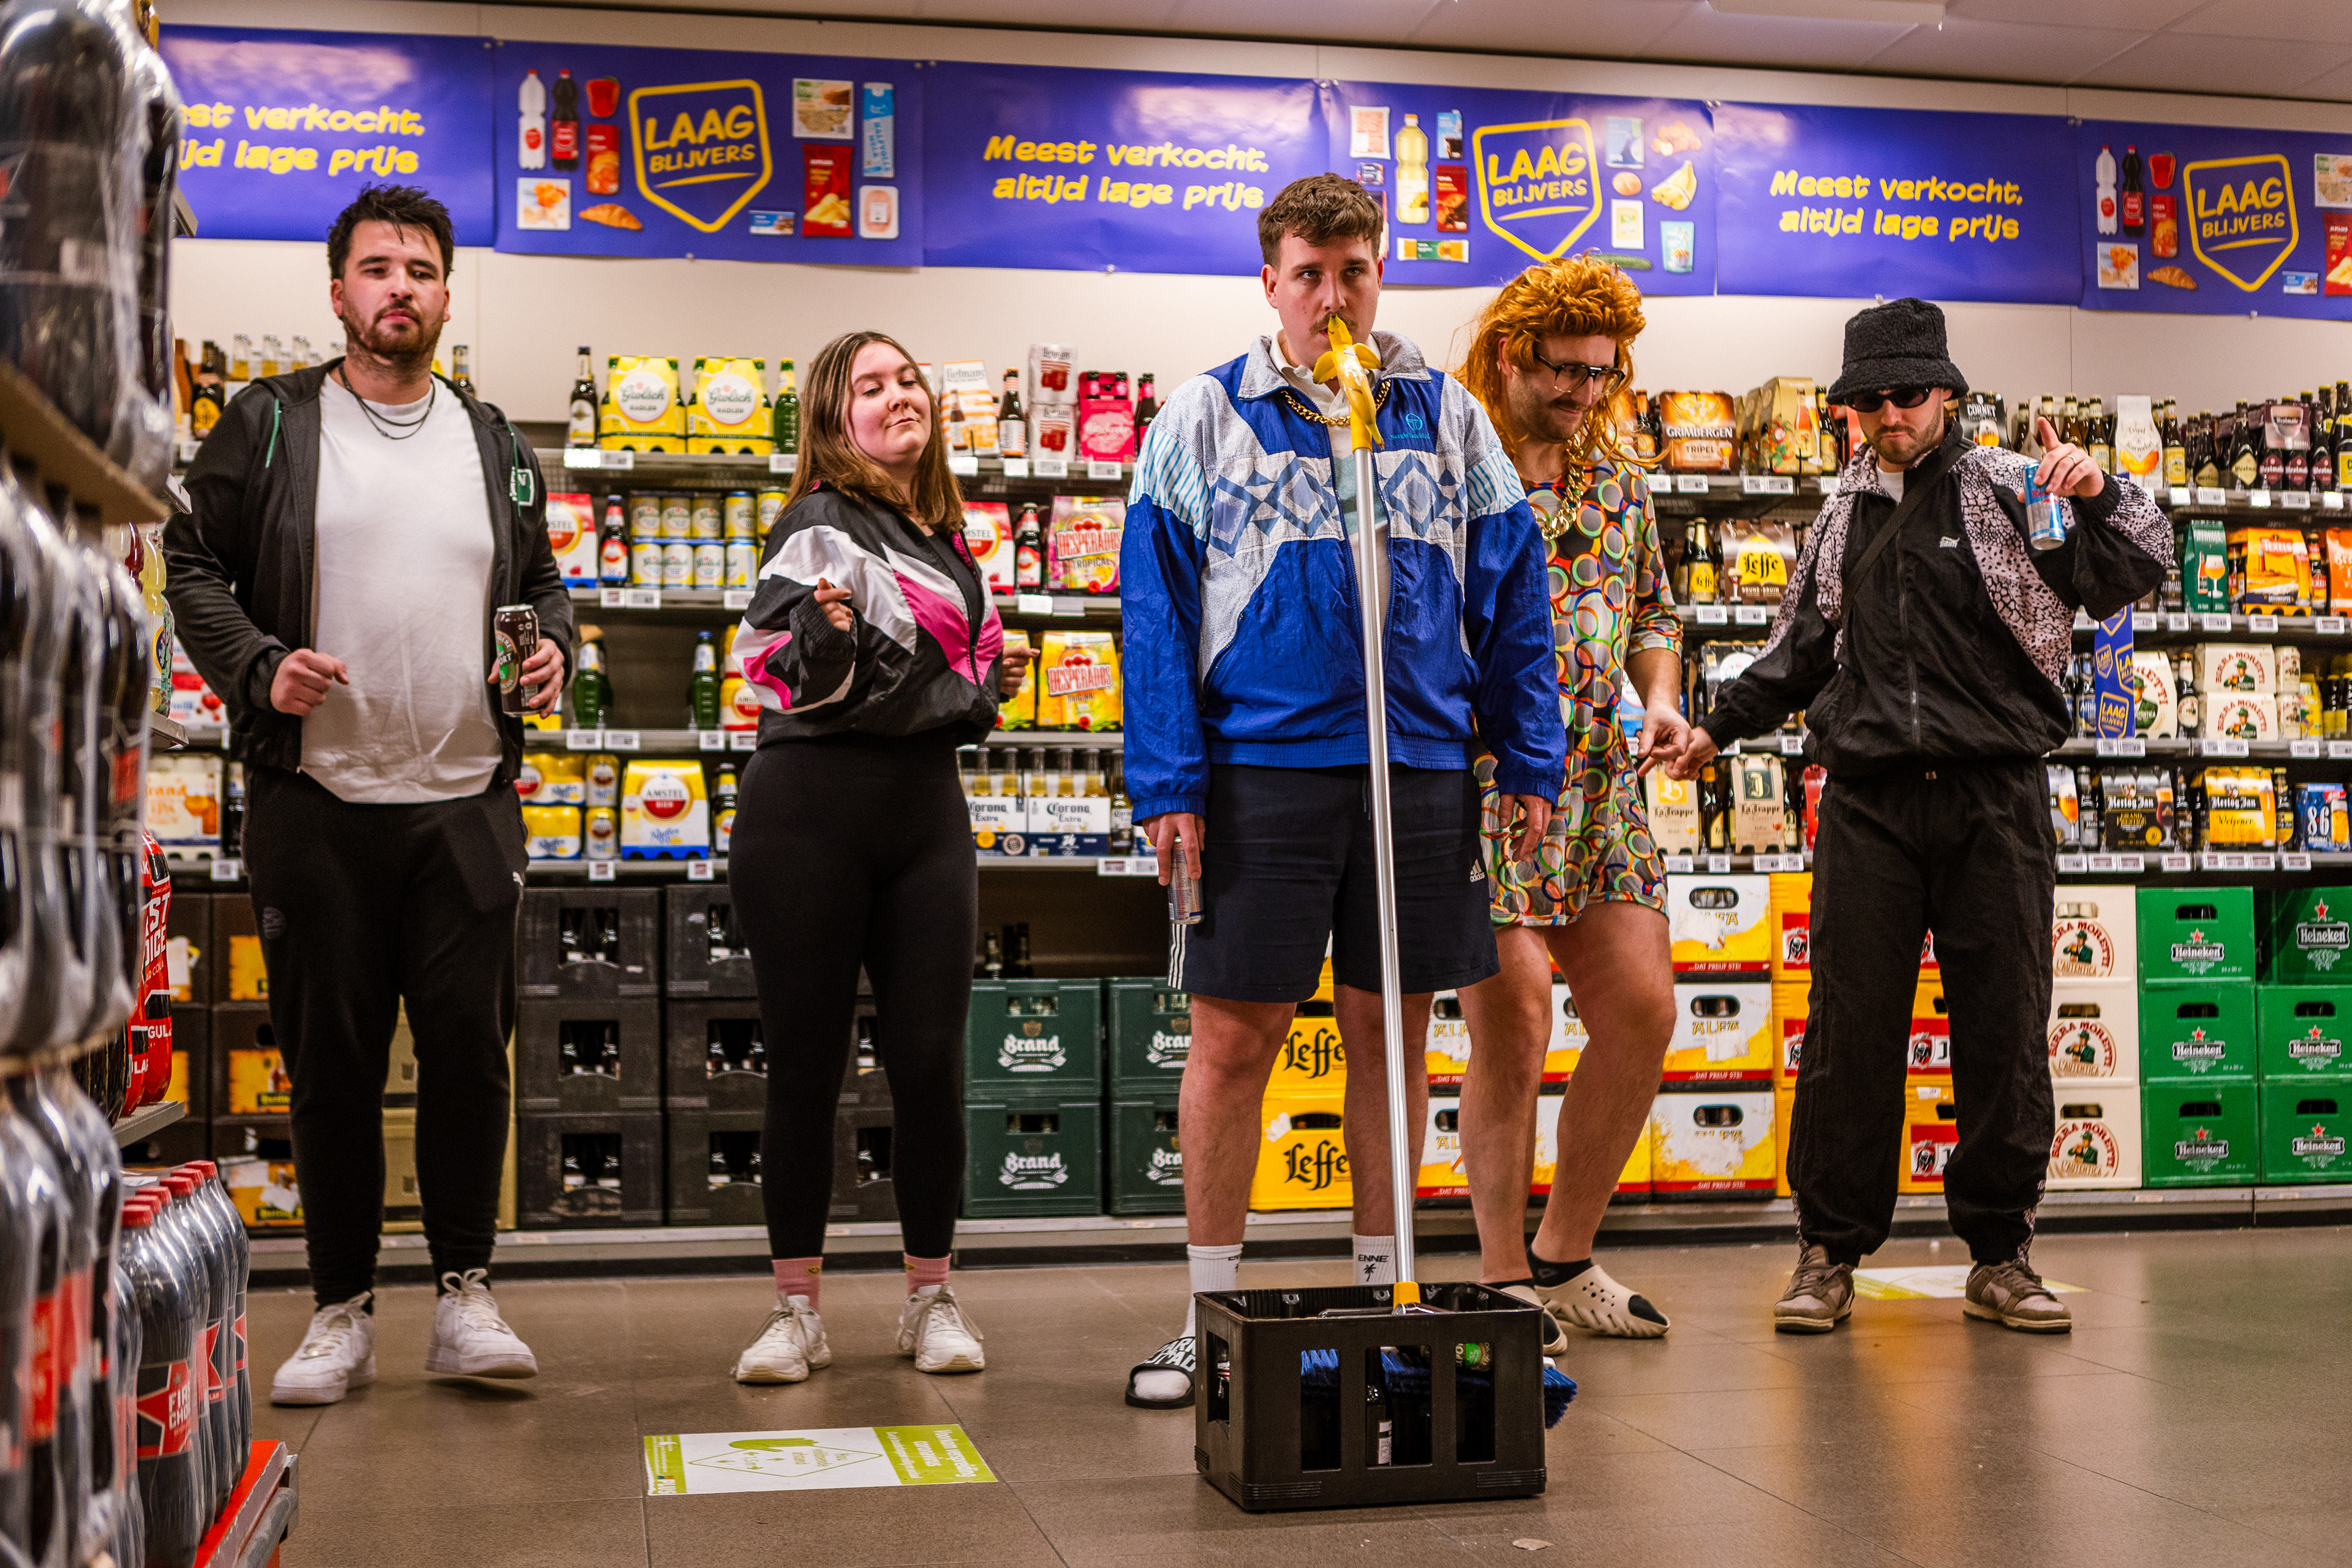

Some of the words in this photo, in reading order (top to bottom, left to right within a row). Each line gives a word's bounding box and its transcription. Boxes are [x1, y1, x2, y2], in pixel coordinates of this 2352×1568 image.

[645, 105, 755, 151] LAAG
[179, 139, 225, 169] ijd
[234, 140, 317, 176] lage
[328, 145, 419, 176] prijs
[649, 144, 756, 173] BLIJVERS
[984, 135, 1097, 164] Meest
[1488, 143, 1587, 186] LAAG
[993, 174, 1089, 203] altijd
[1098, 176, 1173, 208] lage
[1183, 182, 1264, 211] prijs
[1493, 179, 1588, 207] BLIJVERS
[1770, 170, 1871, 198] Meest
[2198, 177, 2285, 218] LAAG
[1779, 206, 1863, 237] altijd
[1874, 209, 1939, 239] lage
[1949, 214, 2019, 241] prijs
[2202, 213, 2286, 238] BLIJVERS
[1967, 403, 1996, 417] CORNET
[1666, 427, 1733, 439] GRIMBERGEN
[1686, 445, 1716, 454] TRIPEL
[548, 521, 571, 530] STEL
[1057, 529, 1121, 557] DESPERADOS
[1072, 557, 1110, 570] TROPICAL
[1744, 551, 1779, 579] Leffe
[499, 654, 511, 665] ORT
[2236, 651, 2265, 684] MORETTI
[1048, 665, 1112, 696] DESPERADOS
[1068, 693, 1096, 703] ORIGINAL
[2102, 703, 2125, 718] LAAG
[2237, 699, 2267, 733] MORETTI
[2101, 717, 2124, 728] BLIJVERS
[646, 789, 684, 799] AMSTEL
[1047, 802, 1091, 815] Corona
[1654, 807, 1664, 818] La
[1664, 806, 1694, 818] Trappe
[1741, 804, 1751, 814] La
[1751, 804, 1781, 815] Trappe
[2078, 921, 2110, 968] MORETTI
[2301, 929, 2345, 943] Heineken
[2176, 946, 2220, 958] Heineken
[1434, 1023, 1468, 1038] ALF
[1565, 1022, 1589, 1036] AL
[1692, 1020, 1740, 1035] ALFA
[1004, 1033, 1061, 1055] Brand
[1282, 1027, 1345, 1079] Leffe
[2049, 1022, 2075, 1058] BIRRA
[2081, 1021, 2112, 1067] MORETTI
[2176, 1044, 2222, 1057] Heineken
[2293, 1042, 2338, 1056] Heineken
[1436, 1136, 1461, 1150] AL
[2051, 1122, 2079, 1158] BIRRA
[2082, 1121, 2116, 1168] MORETTI
[2179, 1143, 2225, 1156] Heineken
[2296, 1140, 2342, 1153] Heineken
[1005, 1152, 1061, 1174] Brand
[1152, 1147, 1183, 1168] Bra
[1283, 1140, 1350, 1191] Leffe
[932, 1430, 963, 1449] Voorkom
[913, 1441, 948, 1466] coronavirus
[656, 1479, 677, 1493] PLUS
